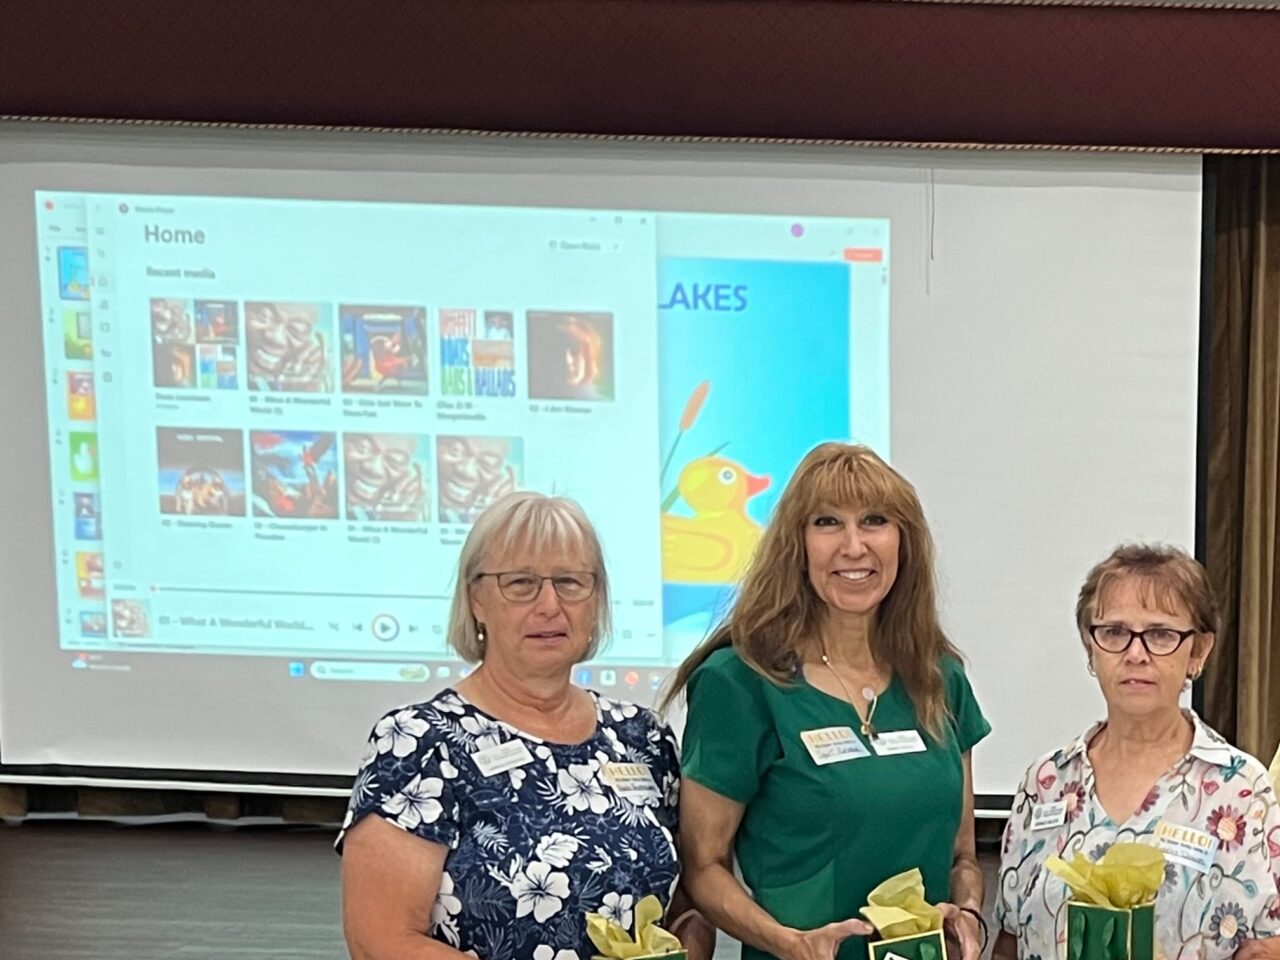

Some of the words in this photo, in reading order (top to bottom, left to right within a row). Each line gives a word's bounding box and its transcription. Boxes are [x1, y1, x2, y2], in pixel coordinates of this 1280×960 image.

[144, 223, 206, 244] Home
[184, 266, 216, 279] media
[1162, 825, 1213, 848] HELLO!
